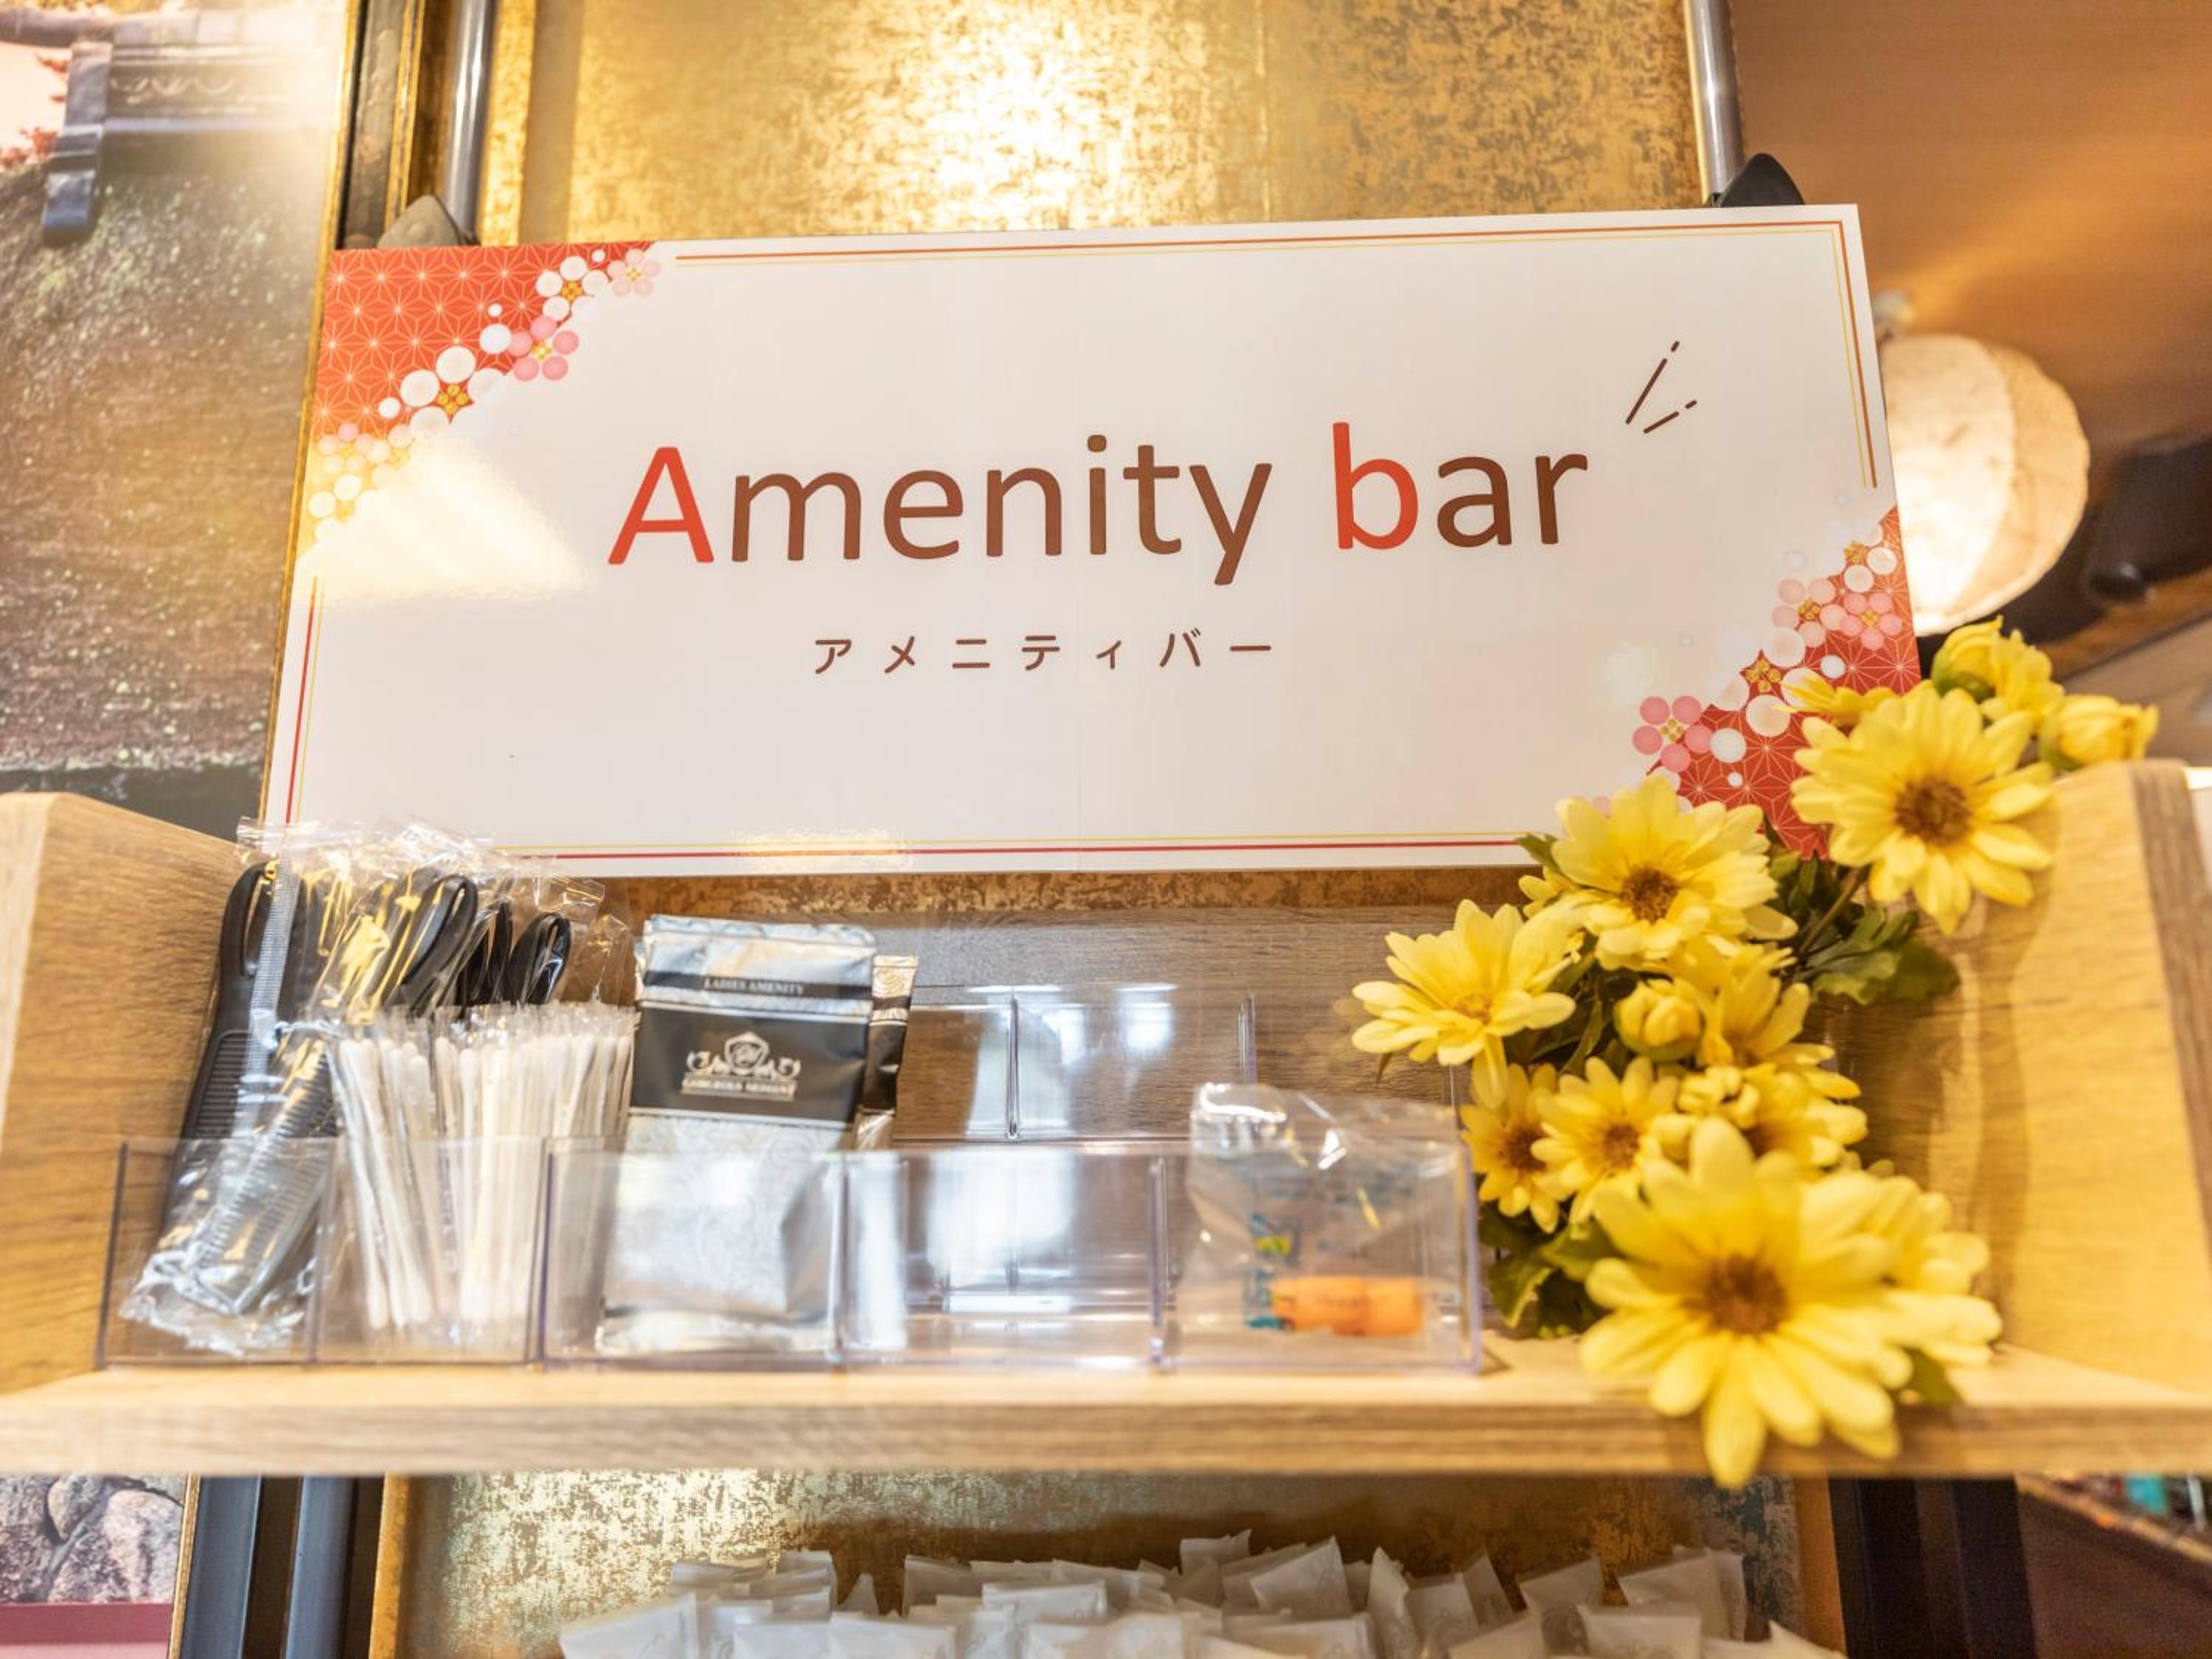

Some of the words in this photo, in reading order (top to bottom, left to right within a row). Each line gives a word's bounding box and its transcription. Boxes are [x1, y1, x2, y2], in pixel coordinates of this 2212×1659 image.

[608, 435, 1273, 585] Amenity
[1333, 422, 1589, 551] bar
[815, 628, 1273, 674] アメニティバー
